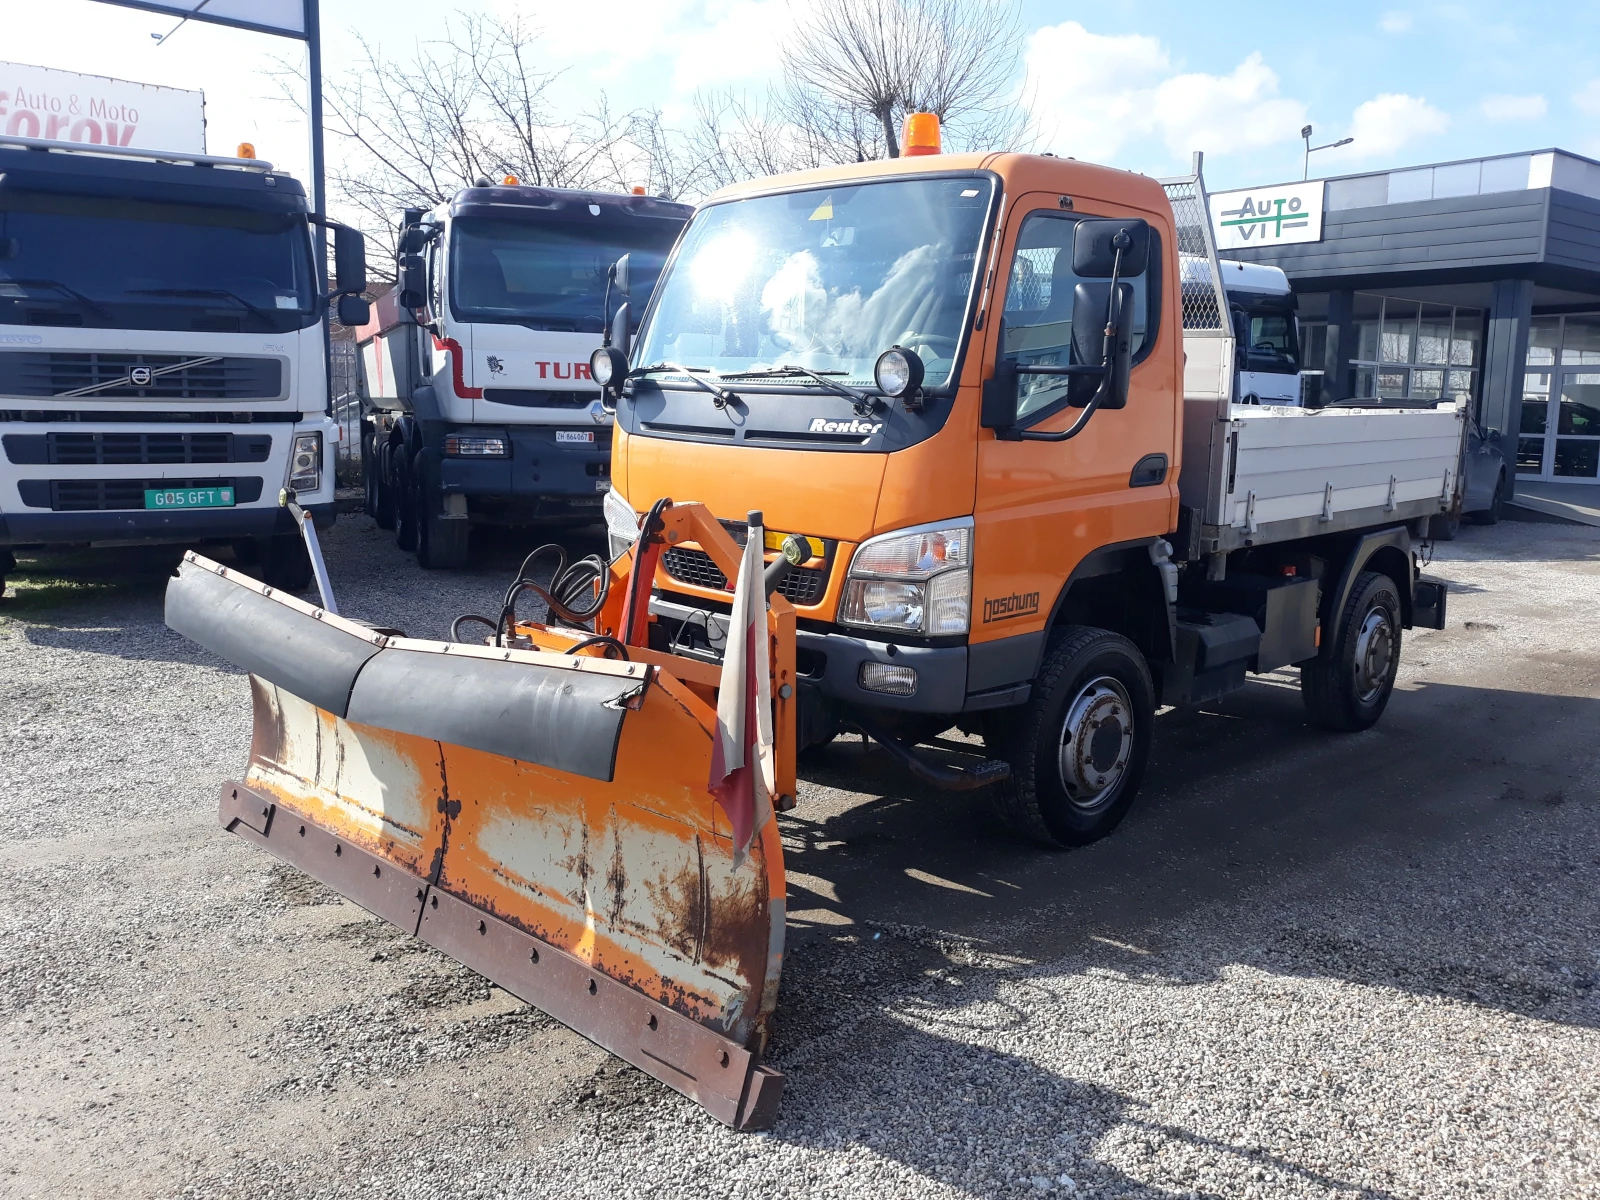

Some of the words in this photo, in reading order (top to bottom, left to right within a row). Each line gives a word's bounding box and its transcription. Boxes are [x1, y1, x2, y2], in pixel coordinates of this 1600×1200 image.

[14, 86, 62, 113] Auto
[68, 94, 82, 116] &
[90, 97, 139, 124] Moto
[809, 418, 883, 434] Rexter
[188, 491, 215, 504] GFT
[983, 592, 1040, 624] boschung
